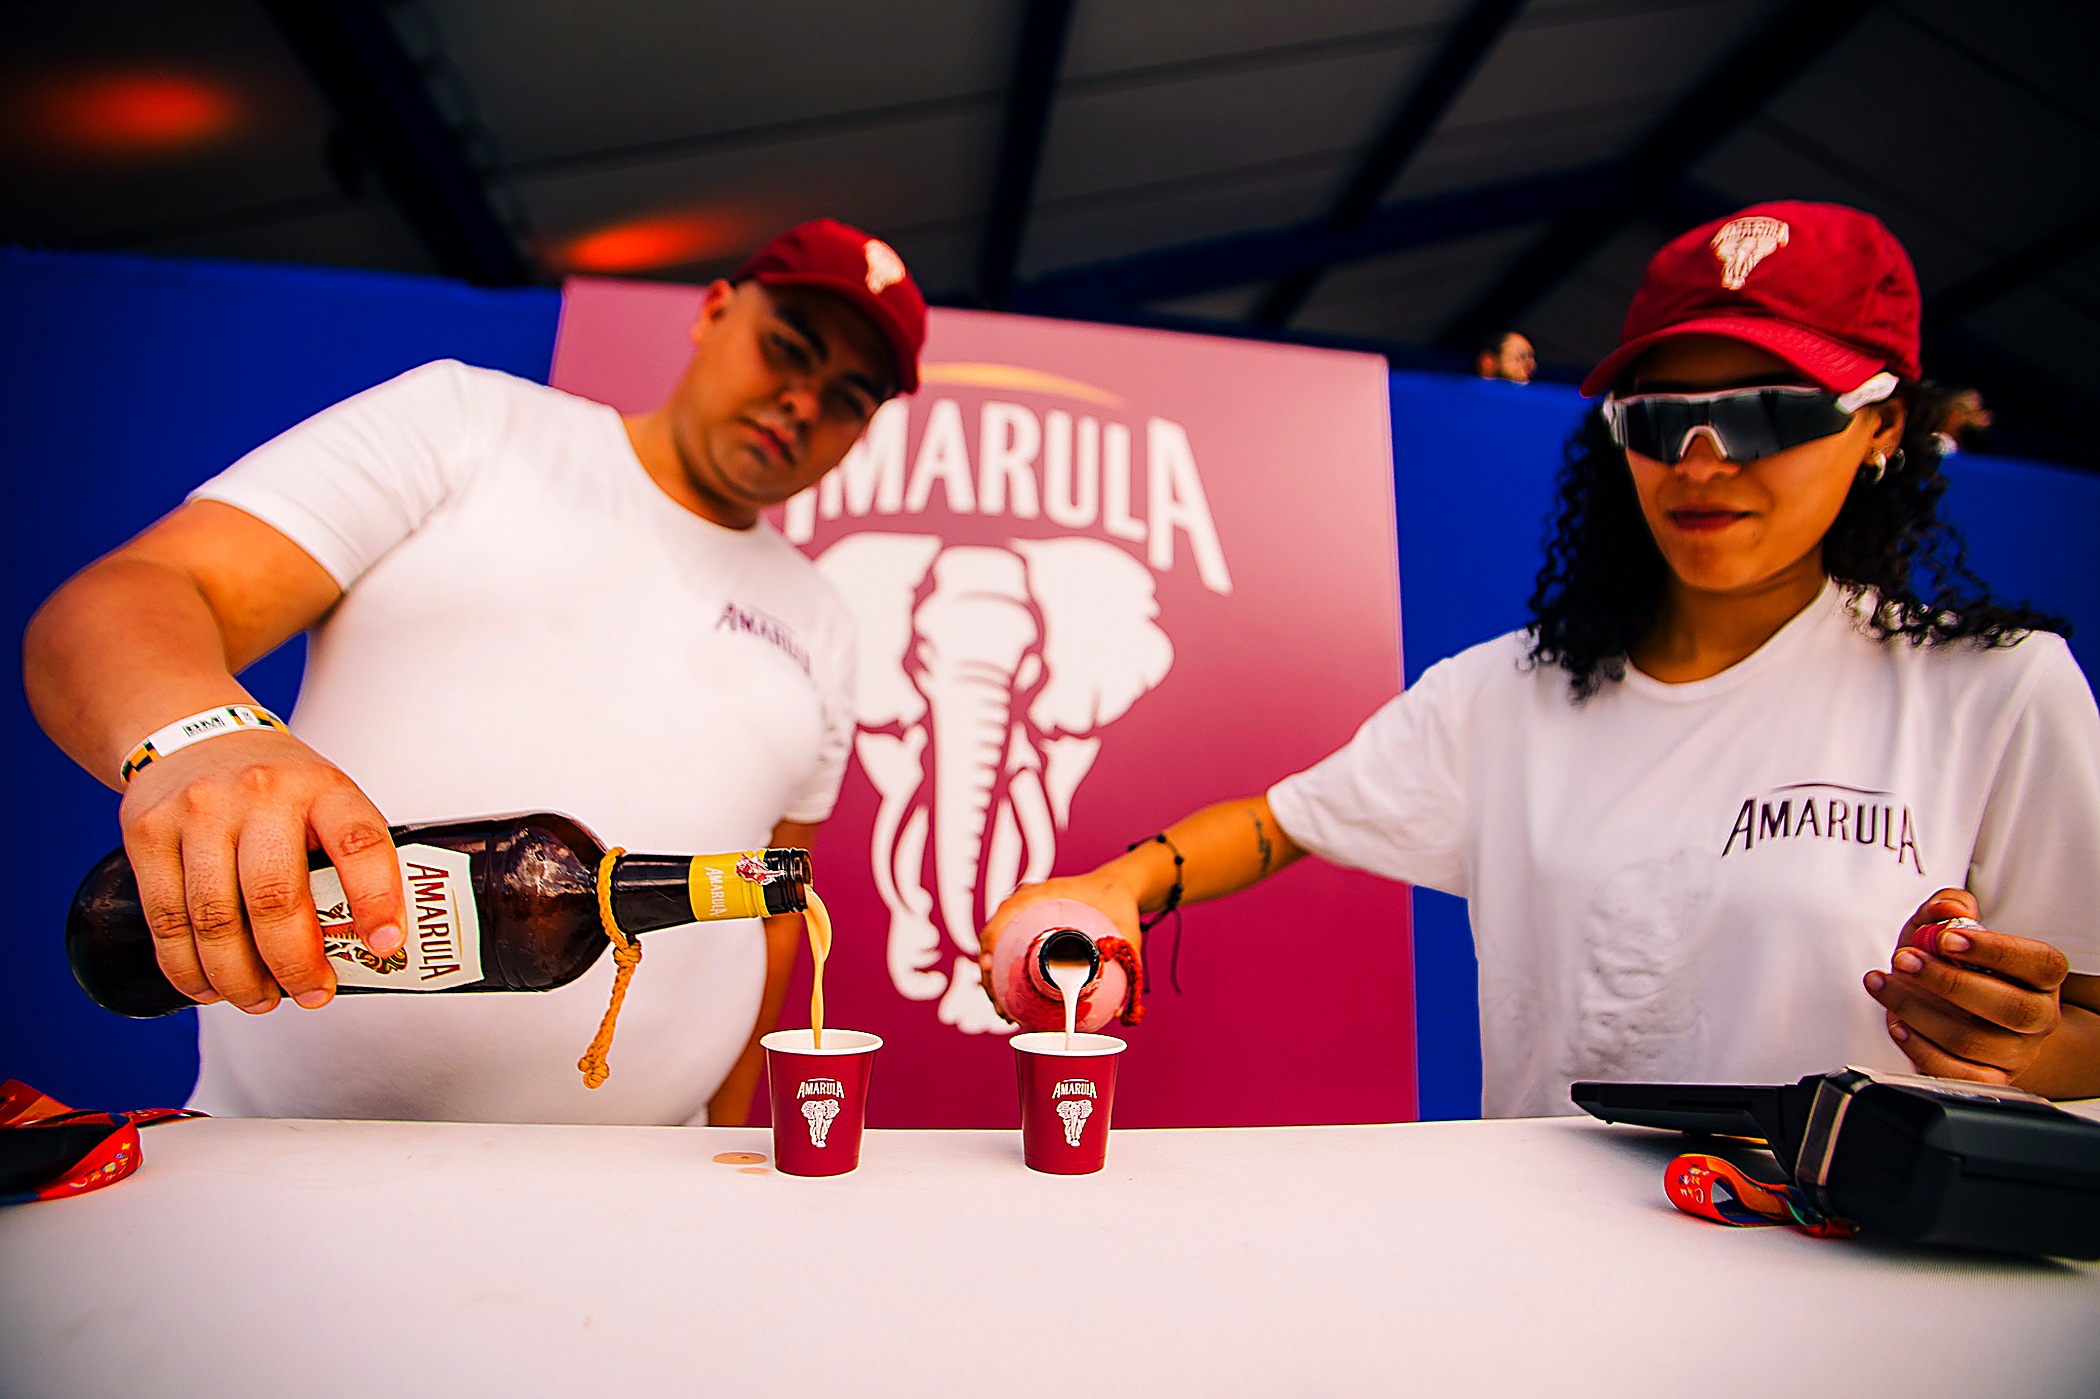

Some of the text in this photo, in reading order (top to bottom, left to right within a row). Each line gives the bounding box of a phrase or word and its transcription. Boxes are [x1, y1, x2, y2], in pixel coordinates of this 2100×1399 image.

[783, 398, 1235, 597] MARULA
[1720, 796, 1926, 876] AMARULA
[406, 862, 461, 981] AMARULA
[704, 866, 728, 917] AMARULA
[797, 1081, 845, 1099] AMARULA
[1052, 1081, 1098, 1099] AMARULA
